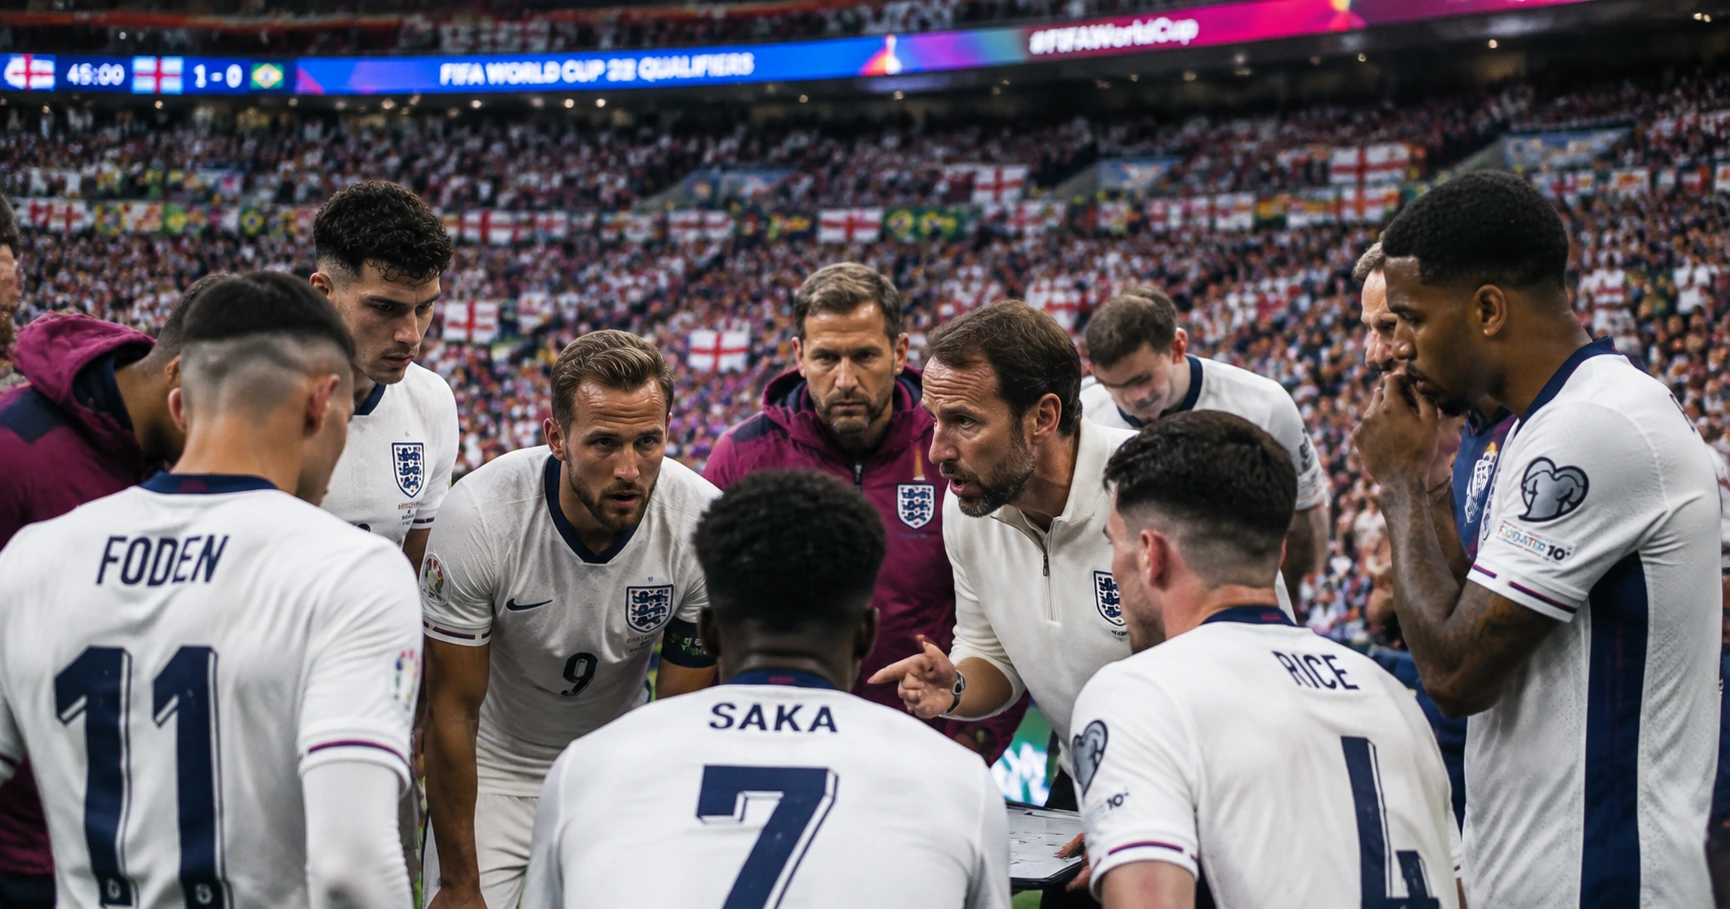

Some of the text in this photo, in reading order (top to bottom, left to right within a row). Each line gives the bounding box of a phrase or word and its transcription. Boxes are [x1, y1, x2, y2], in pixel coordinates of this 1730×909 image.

[440, 62, 485, 86] FIFA
[486, 60, 561, 85] WORLD
[561, 58, 606, 83] CUP
[638, 52, 755, 82] QUALIFIERS
[97, 534, 229, 587] FODEN
[561, 652, 598, 697] 9
[1272, 650, 1360, 690] RICE
[709, 702, 838, 733] SAKA
[54, 645, 233, 909] 11
[696, 764, 839, 909] 7
[1340, 735, 1440, 909] 4
